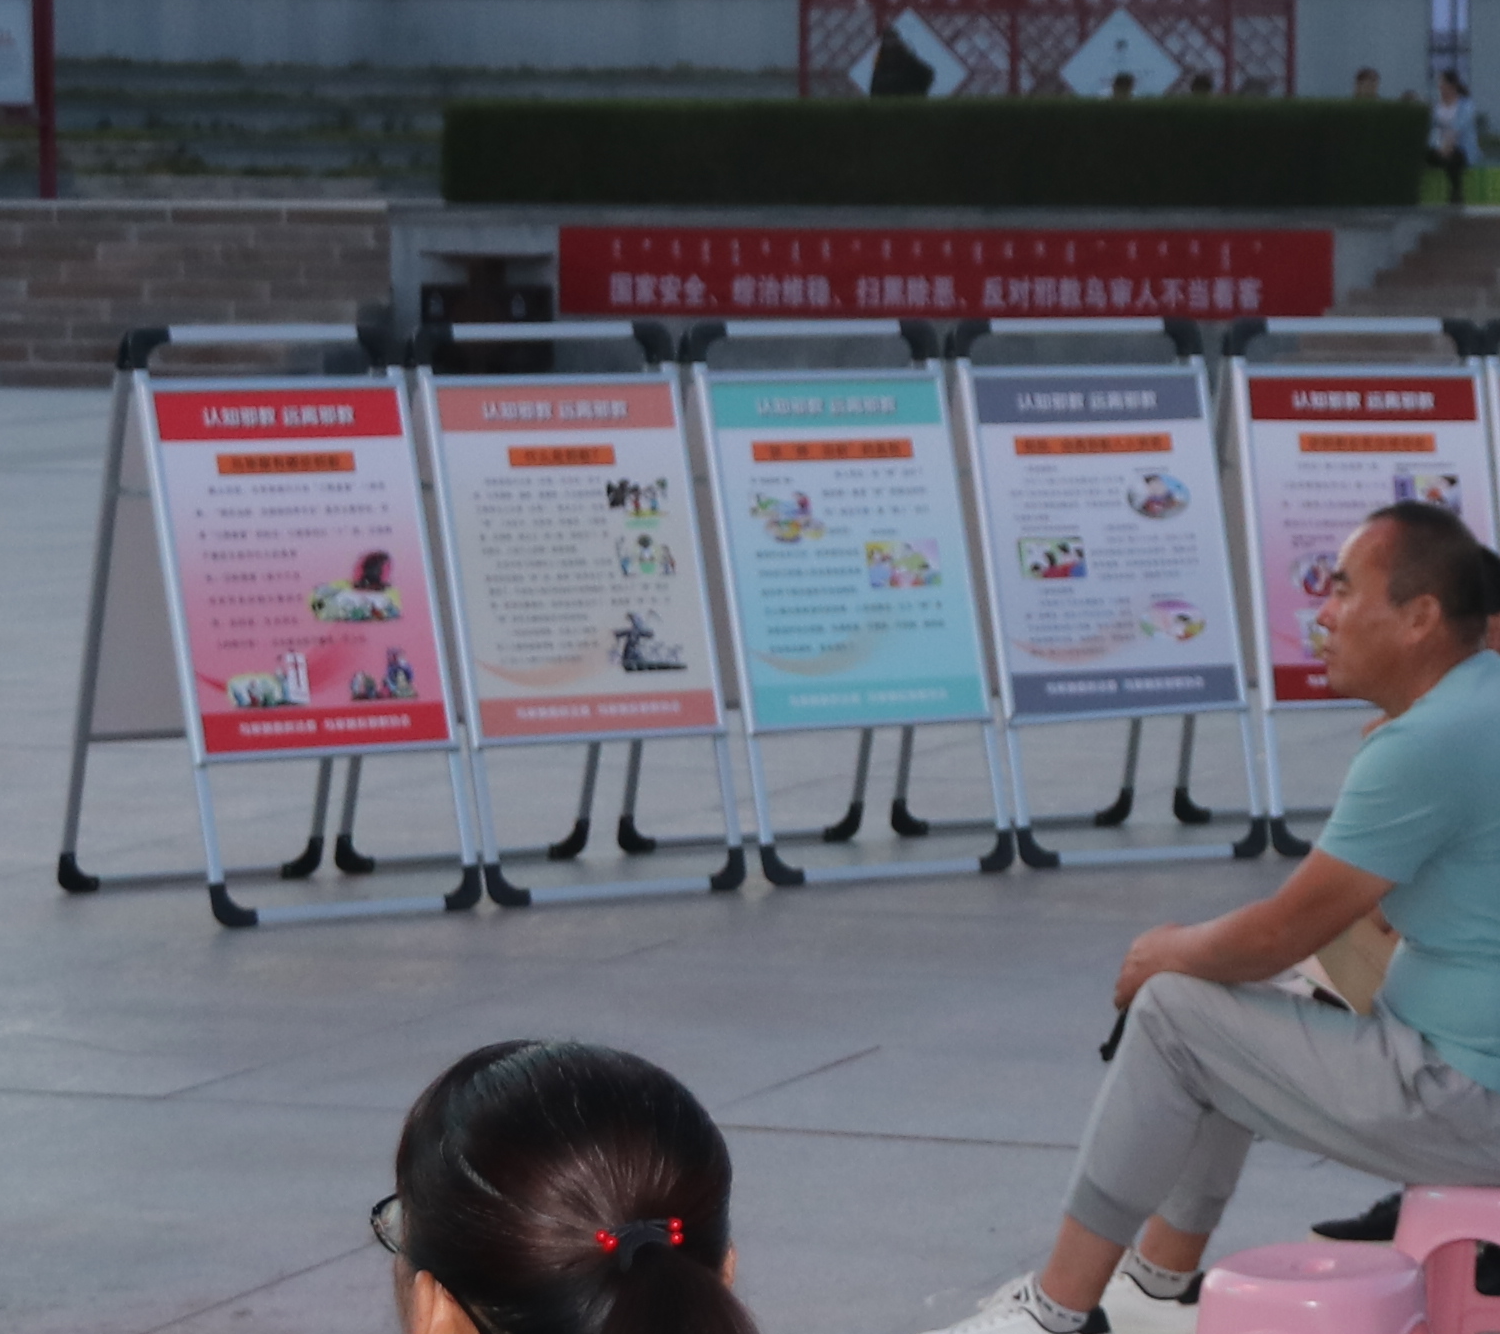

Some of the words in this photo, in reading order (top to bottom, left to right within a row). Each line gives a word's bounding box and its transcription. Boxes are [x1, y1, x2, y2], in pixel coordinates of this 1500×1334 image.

[202, 406, 276, 428] 认知邪教
[282, 403, 355, 427] 远离邪教
